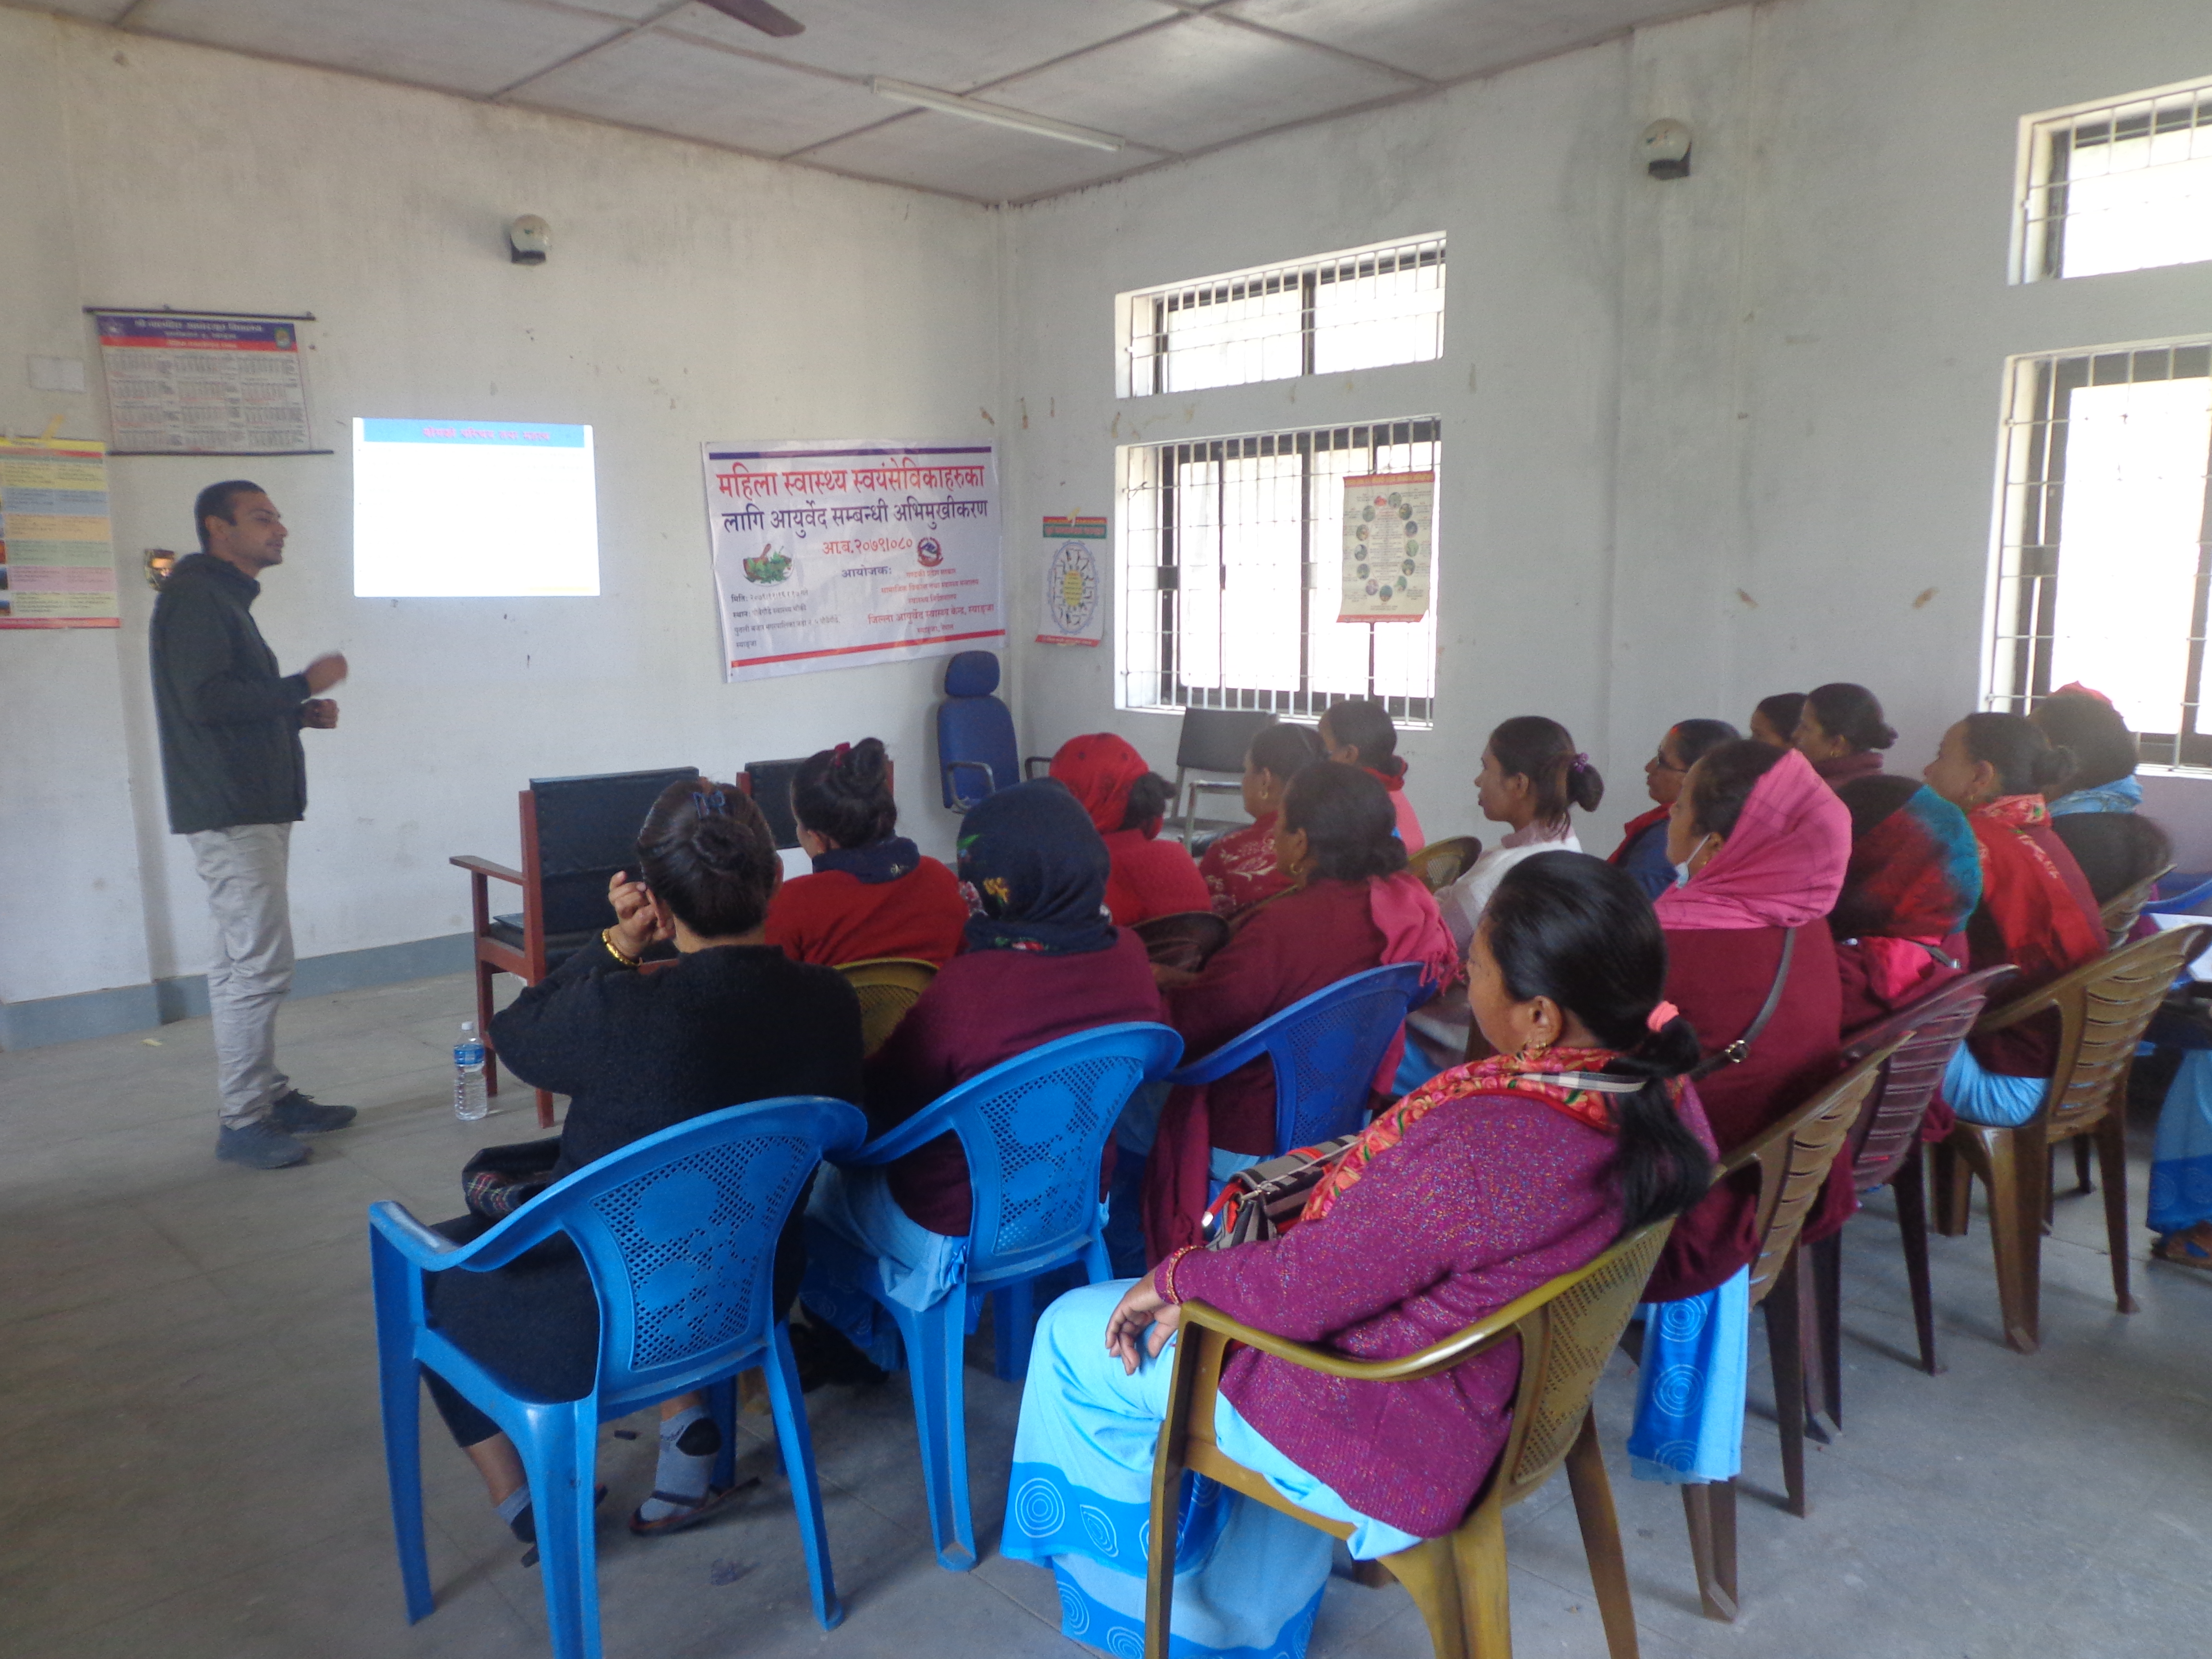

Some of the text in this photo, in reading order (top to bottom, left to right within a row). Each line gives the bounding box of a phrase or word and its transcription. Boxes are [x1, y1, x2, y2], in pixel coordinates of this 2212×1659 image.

[717, 458, 985, 500] महिला स्वास्थ्य स्वयंसेविकाहरुका
[721, 496, 987, 538] लागि आयुर्वेद सम्बन्धी अभिमुखीकरण
[868, 613, 893, 625] जिल्ला
[896, 609, 923, 624] आयुर्वेद
[926, 609, 949, 617] स्वास्थ्य
